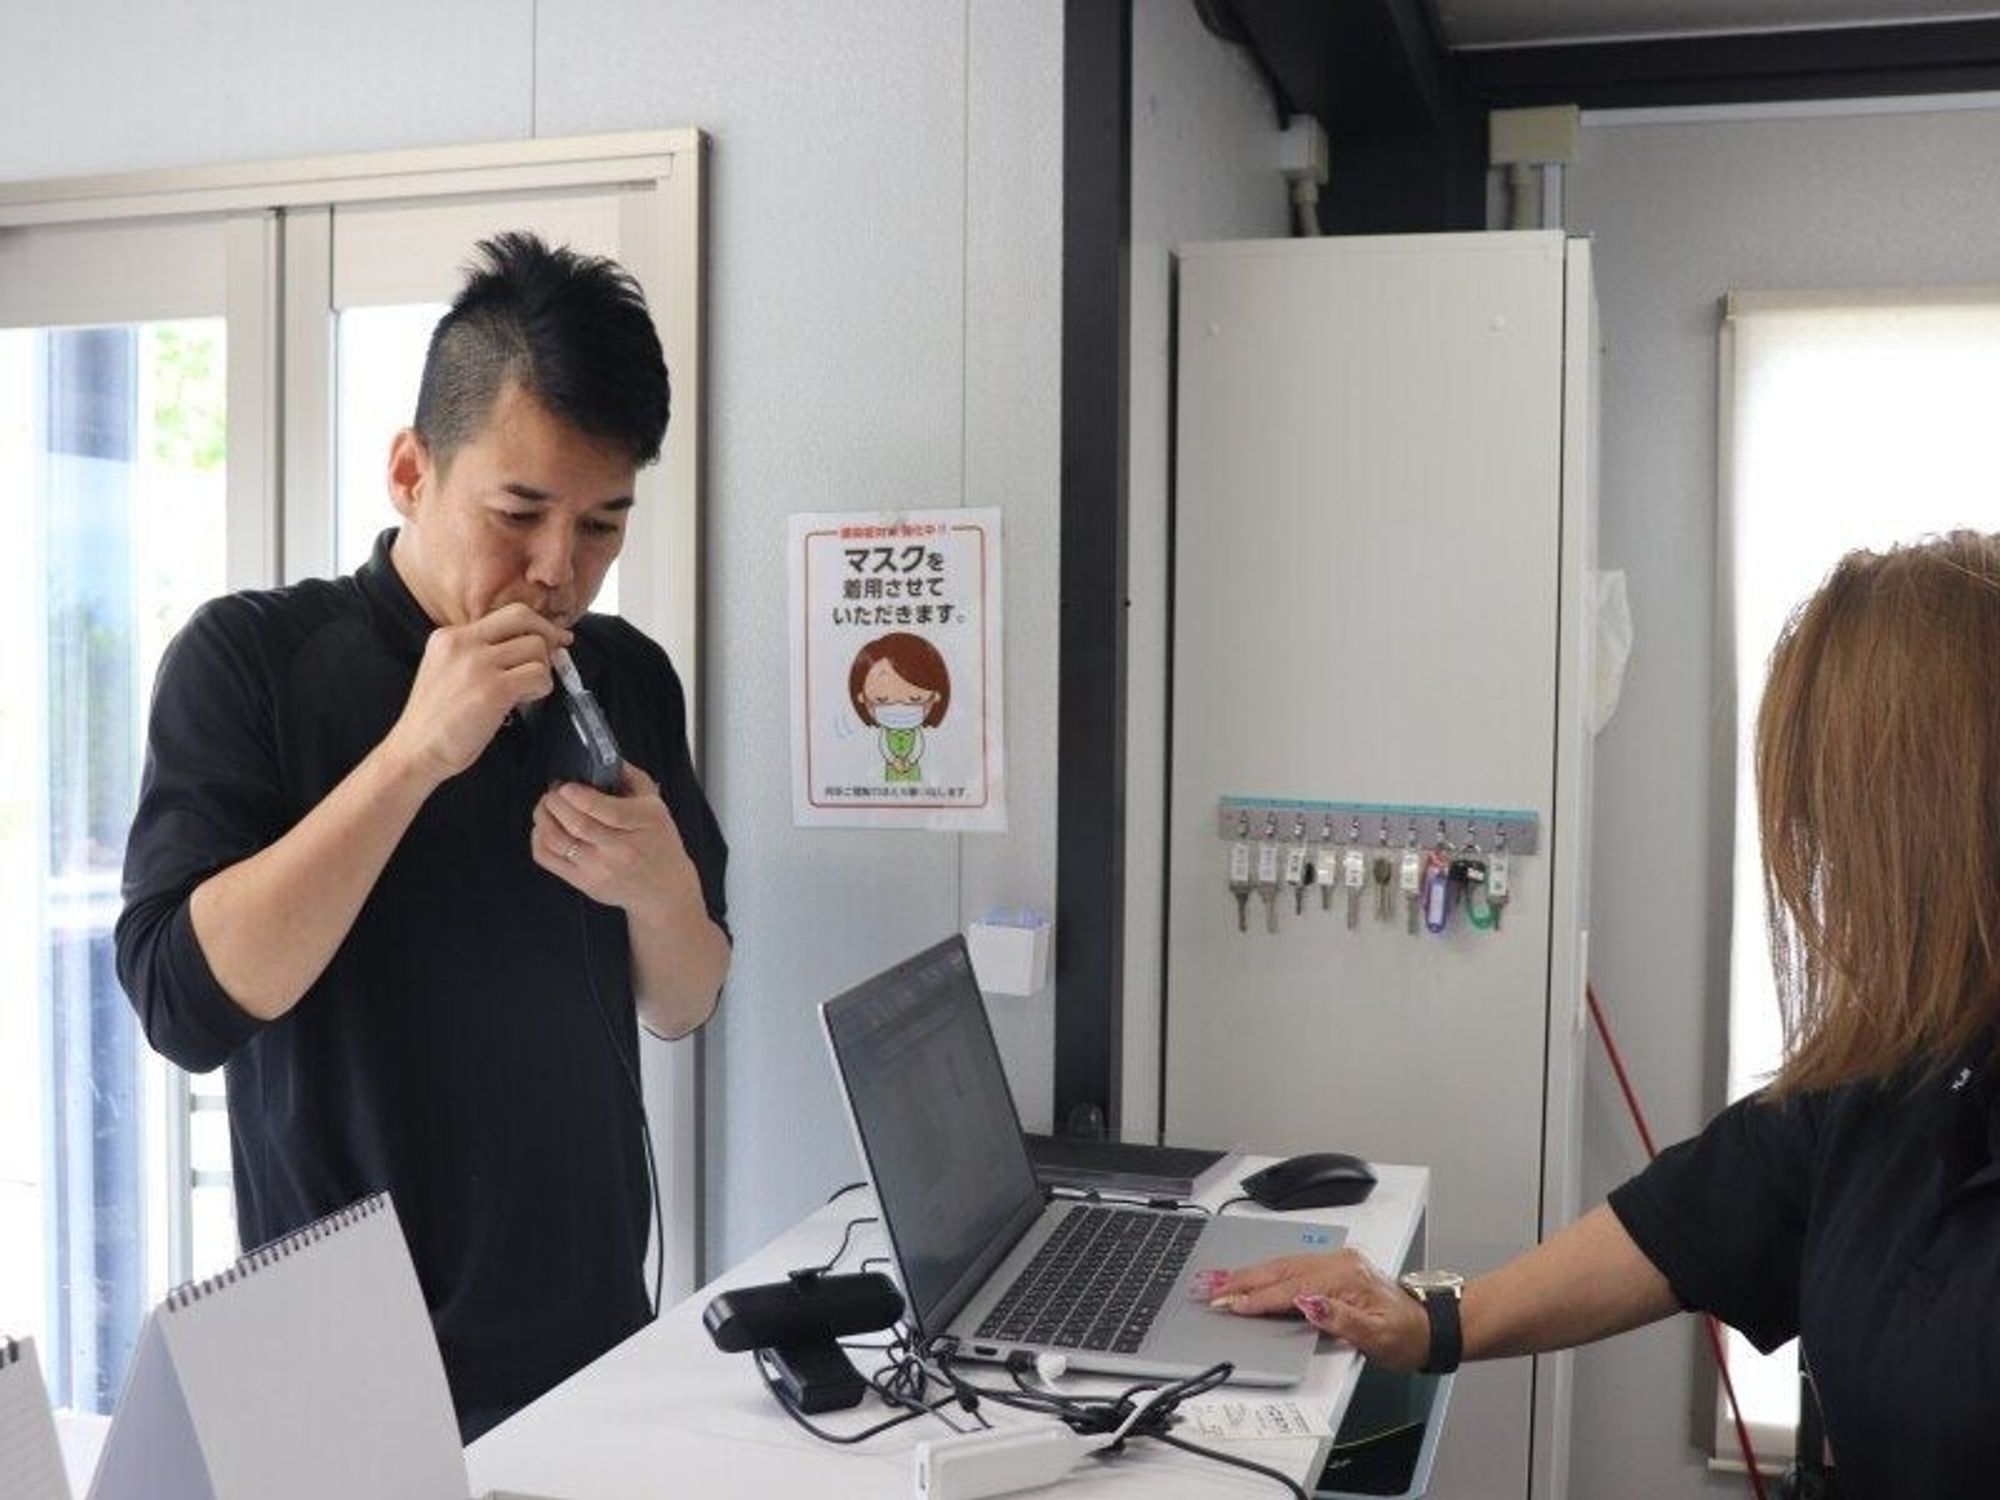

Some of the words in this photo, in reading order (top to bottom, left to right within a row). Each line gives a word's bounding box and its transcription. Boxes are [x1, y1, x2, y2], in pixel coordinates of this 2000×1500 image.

[844, 546, 945, 573] マスクを
[843, 578, 944, 599] 着用させて
[832, 605, 966, 625] いただきます。
